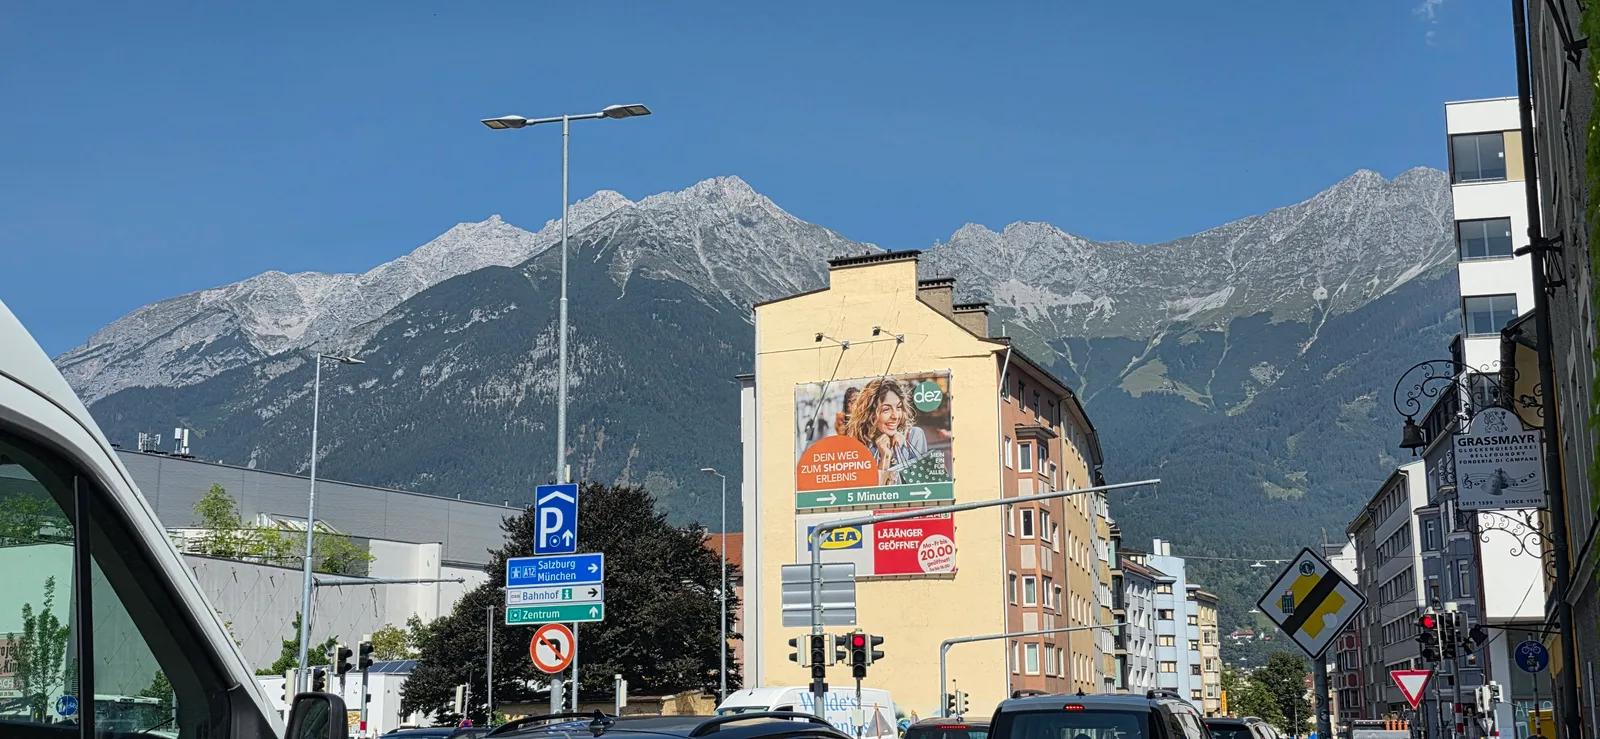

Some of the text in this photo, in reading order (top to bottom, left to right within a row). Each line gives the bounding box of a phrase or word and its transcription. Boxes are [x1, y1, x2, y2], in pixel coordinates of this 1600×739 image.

[914, 385, 941, 403] dez
[1458, 435, 1534, 446] GRASSMAYR
[814, 451, 858, 461] DEIN WEG
[801, 461, 871, 474] ZUM SHOPPING
[816, 472, 857, 483] ERLEBNIS
[847, 492, 899, 502] 5 Minuten
[540, 507, 564, 548] P
[878, 528, 922, 538] LÄÄÄNGER
[878, 540, 919, 550] GEÖFFNET
[921, 545, 952, 560] 20.00
[523, 561, 575, 576] A12 Salzburg
[538, 572, 576, 581] München
[522, 590, 559, 600] Bahnhof
[522, 610, 560, 619] Zentrum
